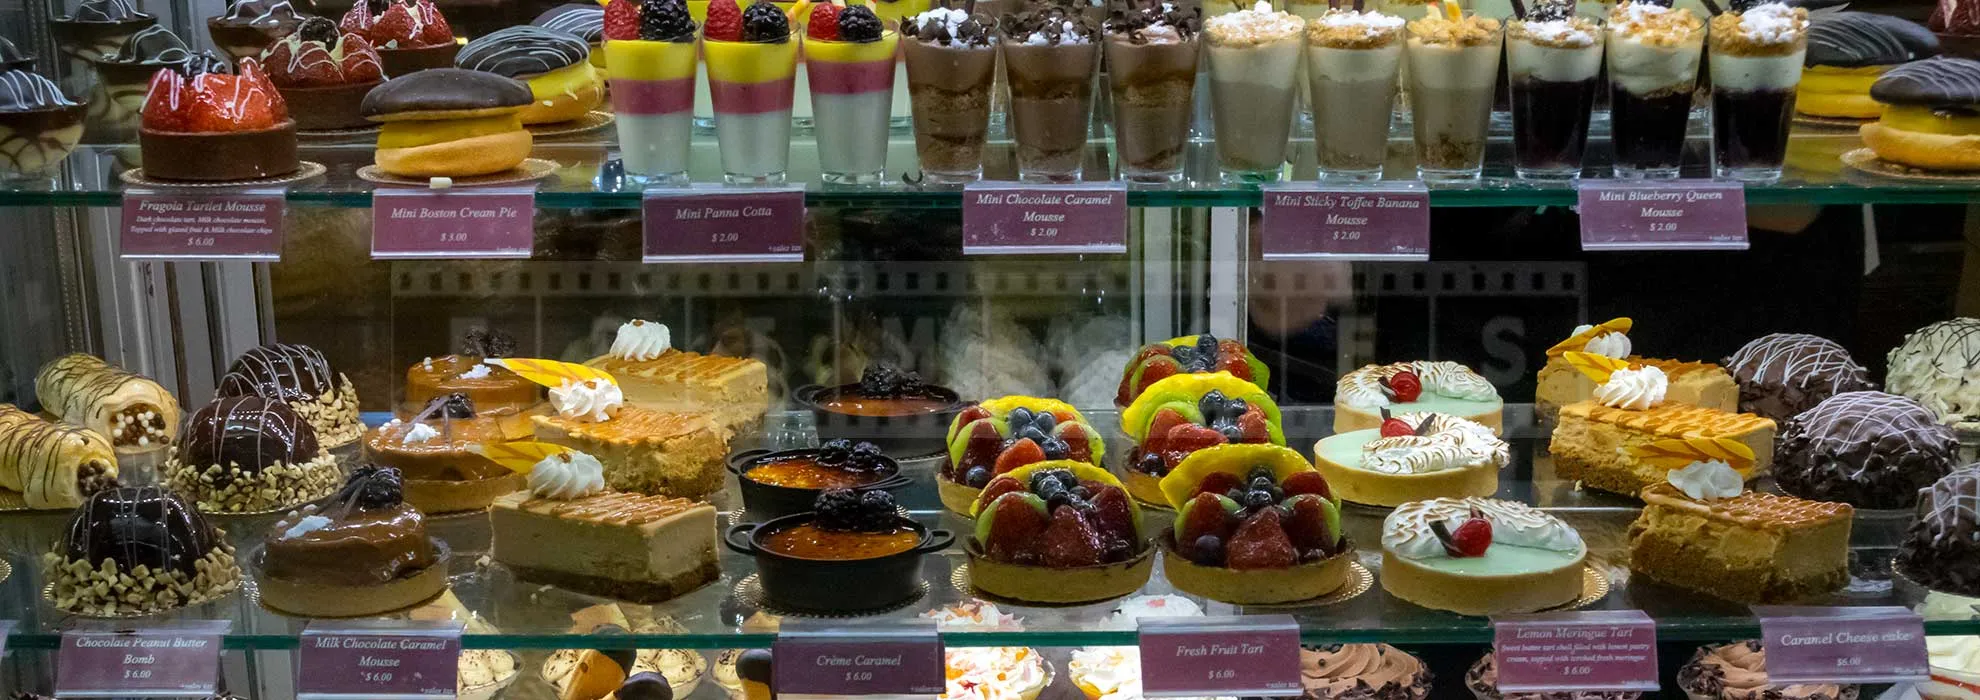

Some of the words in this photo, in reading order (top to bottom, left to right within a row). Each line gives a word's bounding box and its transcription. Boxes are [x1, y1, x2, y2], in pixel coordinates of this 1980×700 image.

[976, 194, 1004, 205] Mini
[1006, 194, 1062, 205] Chocolate
[1064, 194, 1112, 206] Caramel
[1599, 190, 1626, 202] Mini
[1628, 190, 1684, 202] Blueberry
[1686, 190, 1723, 202] Queen
[139, 200, 183, 214] Fragola
[187, 200, 222, 211] Tartlet
[224, 200, 266, 212] Mousse
[1274, 195, 1301, 207] Mini
[1304, 196, 1338, 209] Sticky
[1340, 196, 1374, 210] Toffee
[1376, 197, 1420, 208] Banana
[391, 208, 416, 218] Mini
[420, 208, 457, 218] Boston
[460, 207, 496, 218] Cream
[498, 207, 518, 218] Pie
[676, 208, 702, 220] Mini
[704, 206, 739, 218] Panna
[742, 206, 772, 217] Cotta
[1023, 211, 1066, 222] Mousse
[1640, 206, 1684, 218] Mousse
[1325, 214, 1368, 226] Mousse
[1038, 228, 1058, 236] 2.00
[1656, 222, 1678, 232] 2.00
[448, 232, 468, 242] 3.00
[719, 232, 739, 242] 2.00
[1340, 230, 1361, 240] 2.00
[195, 238, 215, 246] 6.00
[1516, 628, 1552, 638] Lemon
[1556, 627, 1607, 640] Meringue
[1610, 626, 1634, 638] Tart
[1781, 632, 1832, 646] Caramel
[1836, 632, 1879, 644] Cheese
[1882, 630, 1911, 642] cake
[76, 636, 130, 648] Chocolate
[132, 638, 170, 648] Peanut
[172, 638, 208, 648] Butter
[315, 637, 340, 648] Milk
[342, 638, 397, 650] Chocolate
[400, 638, 446, 650] Caramel
[1176, 645, 1208, 657] Fresh
[1210, 644, 1238, 656] Fruit
[1240, 644, 1264, 654] Tart
[123, 654, 155, 664] Bomb
[358, 656, 400, 667] Mousse
[854, 654, 902, 666] Caramel
[1837, 658, 1861, 666] $6.00
[132, 670, 152, 679] 6.00
[1216, 670, 1235, 679] 6.00
[1571, 666, 1591, 674] 6.00
[373, 672, 392, 682] 6.00
[853, 672, 873, 682] 6.00
